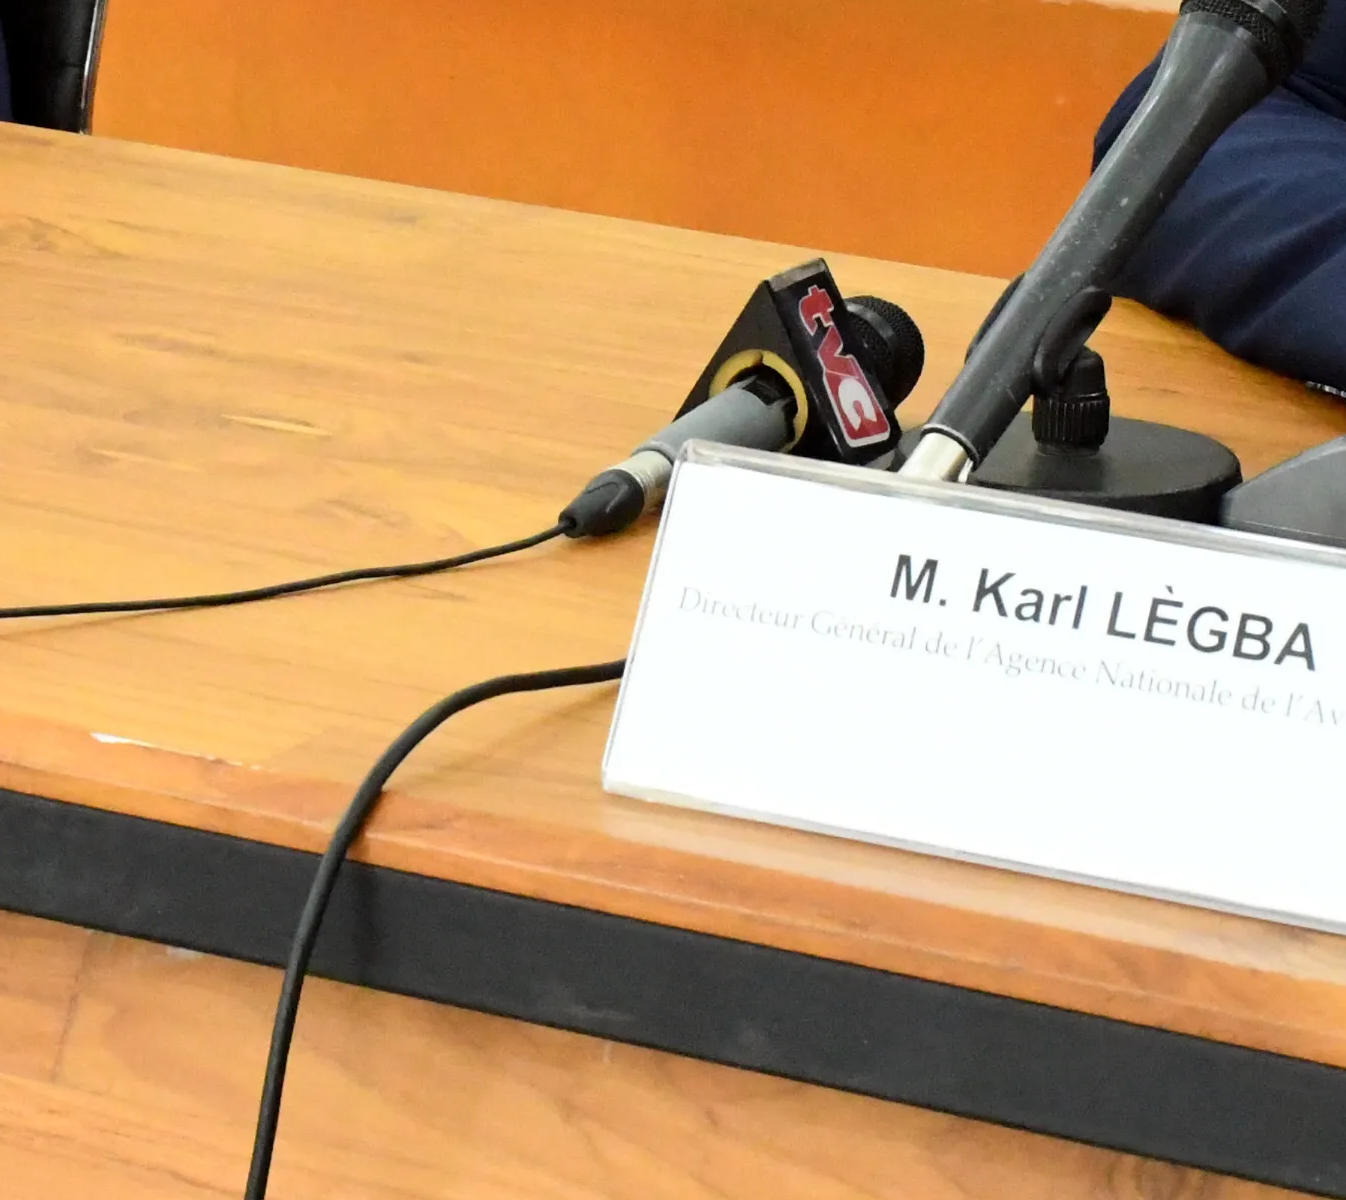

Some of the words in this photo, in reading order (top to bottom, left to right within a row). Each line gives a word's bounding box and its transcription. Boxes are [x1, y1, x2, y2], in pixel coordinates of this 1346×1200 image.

[679, 585, 804, 630] Directeur
[811, 609, 917, 651] Général
[924, 631, 958, 657] de
[1096, 659, 1233, 707] Nationale
[1241, 685, 1277, 714] de
[890, 553, 947, 606] M.
[972, 567, 1089, 630] Karl
[1106, 584, 1317, 672] LÈGBA
